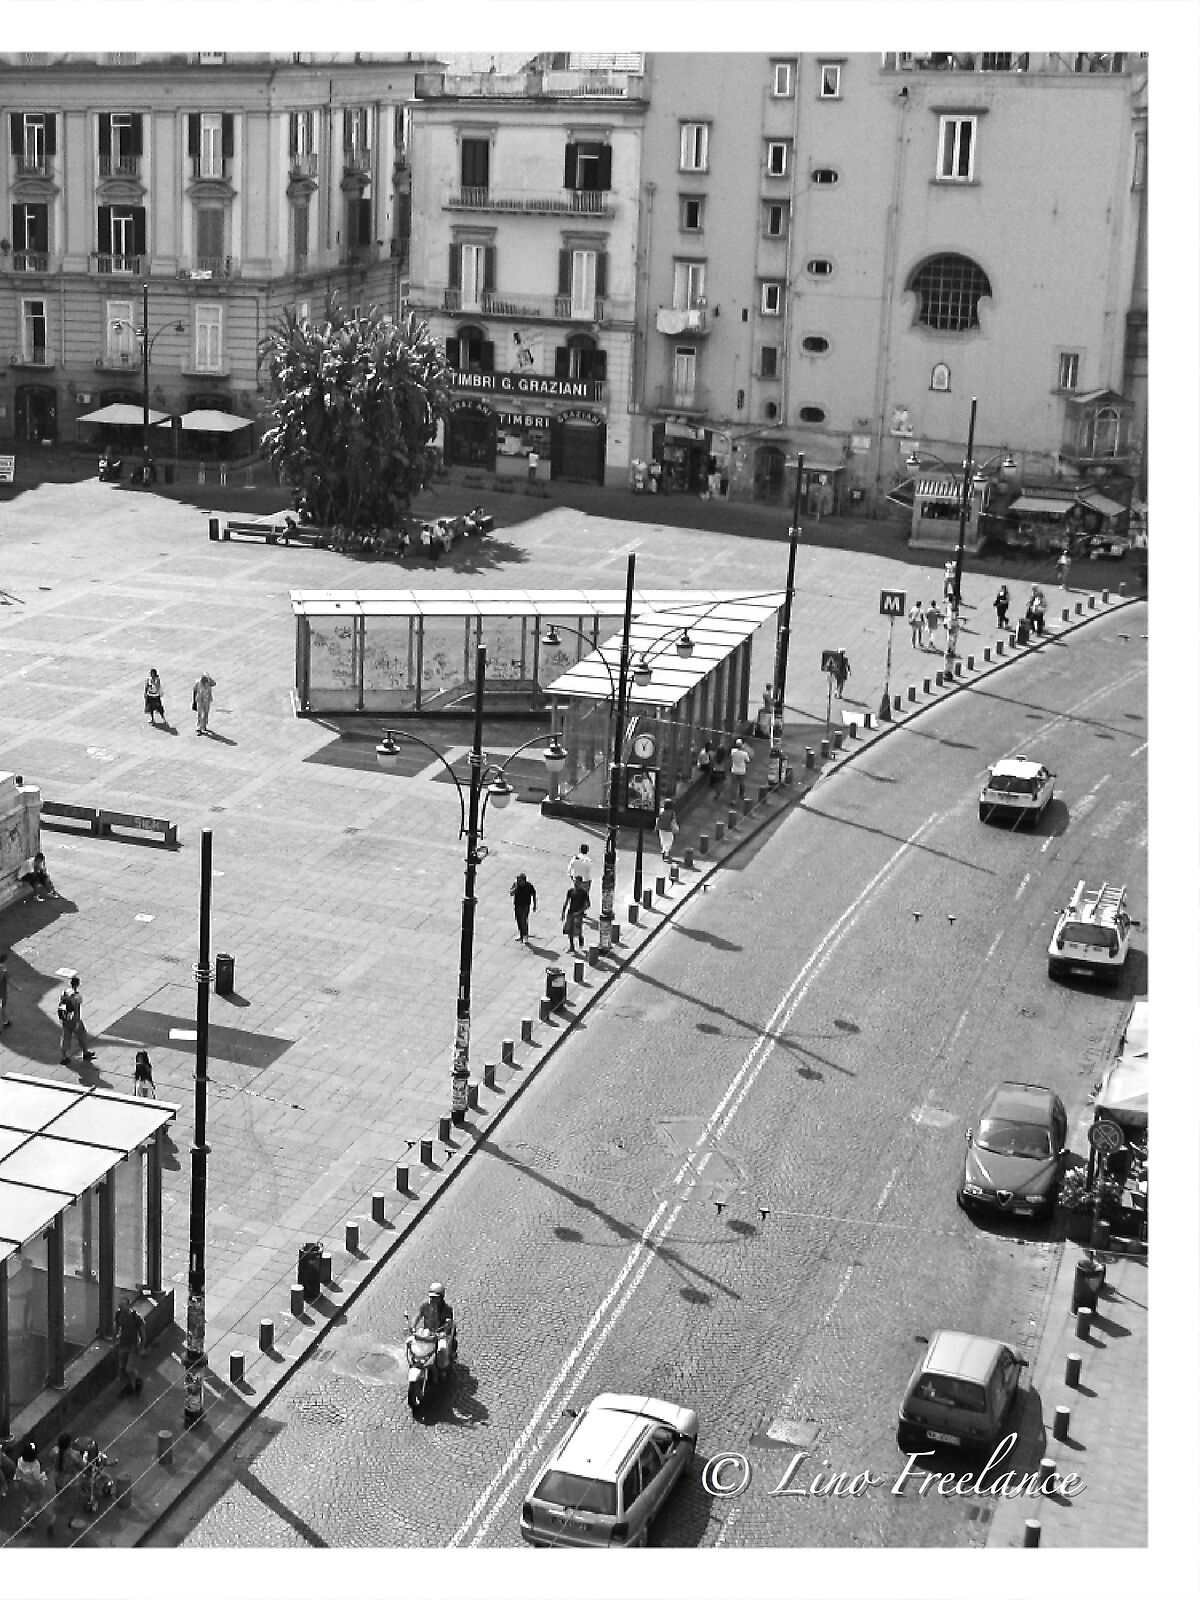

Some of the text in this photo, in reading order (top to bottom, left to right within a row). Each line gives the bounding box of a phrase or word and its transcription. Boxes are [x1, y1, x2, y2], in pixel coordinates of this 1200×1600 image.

[451, 373, 588, 396] TIMBRI G. GRAZIANI
[498, 413, 550, 428] TIMBRI
[884, 596, 900, 612] M
